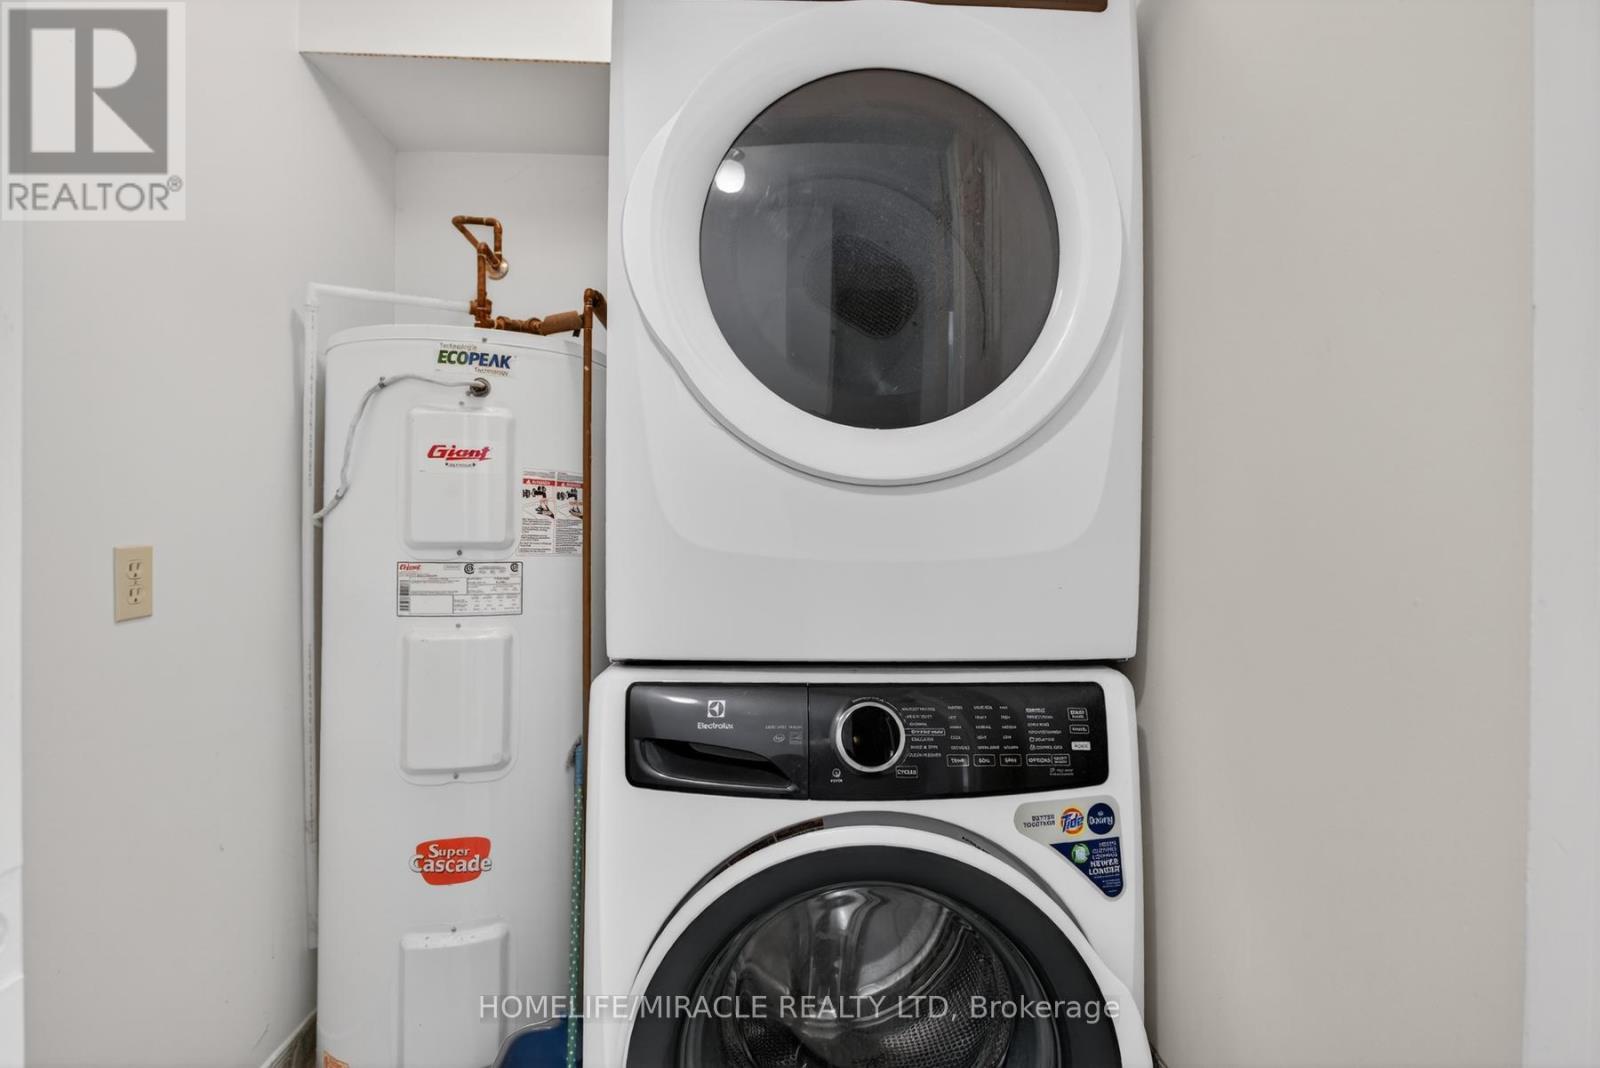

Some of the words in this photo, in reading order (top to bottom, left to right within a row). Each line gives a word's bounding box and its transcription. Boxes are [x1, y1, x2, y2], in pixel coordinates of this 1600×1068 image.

[437, 349, 512, 369] ECOPEAK
[427, 444, 491, 461] Giant
[697, 721, 734, 730] Electrolux
[1061, 813, 1084, 832] Tide
[1089, 816, 1113, 826] Downy
[428, 843, 470, 859] Super
[408, 854, 493, 873] Cascade
